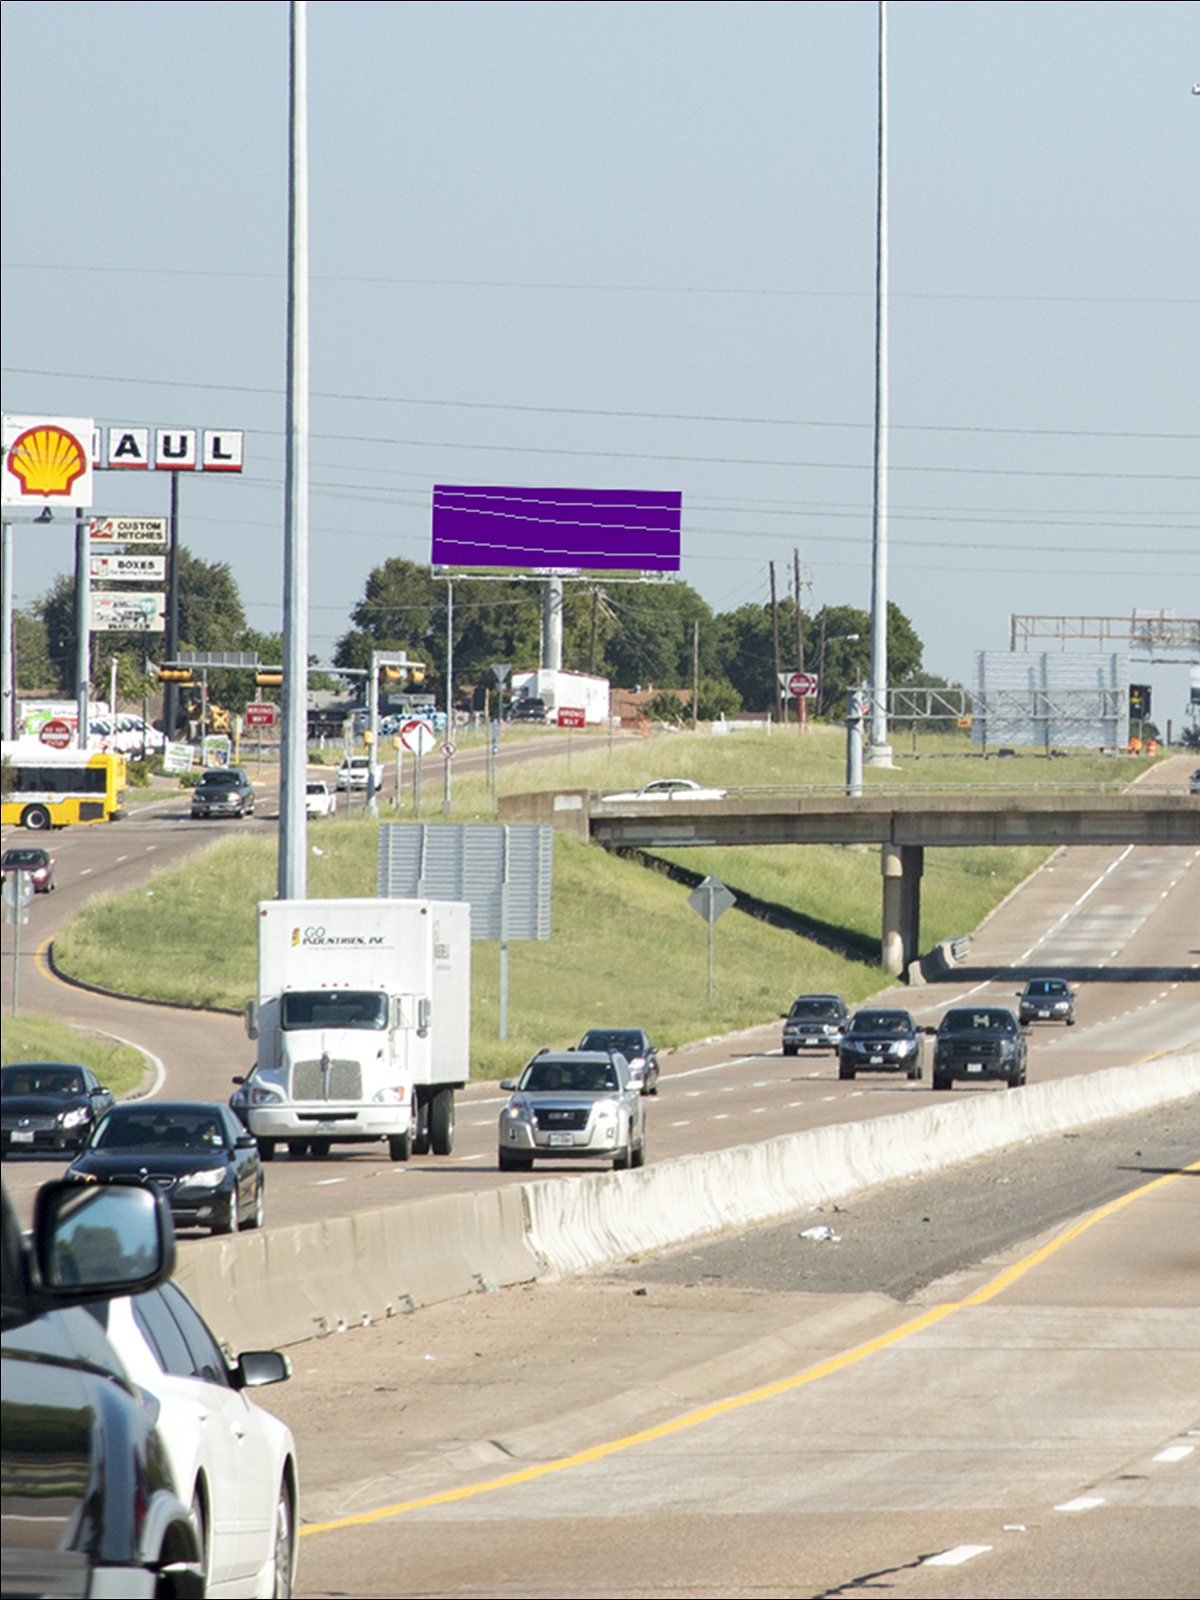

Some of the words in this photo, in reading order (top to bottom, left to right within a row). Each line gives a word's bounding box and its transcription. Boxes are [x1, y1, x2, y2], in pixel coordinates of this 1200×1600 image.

[92, 433, 233, 460] AUL
[117, 521, 162, 531] CUSTOM
[117, 531, 163, 540] HITCHES
[118, 560, 155, 570] BOXES
[252, 715, 269, 723] WAY
[303, 926, 327, 939] GO
